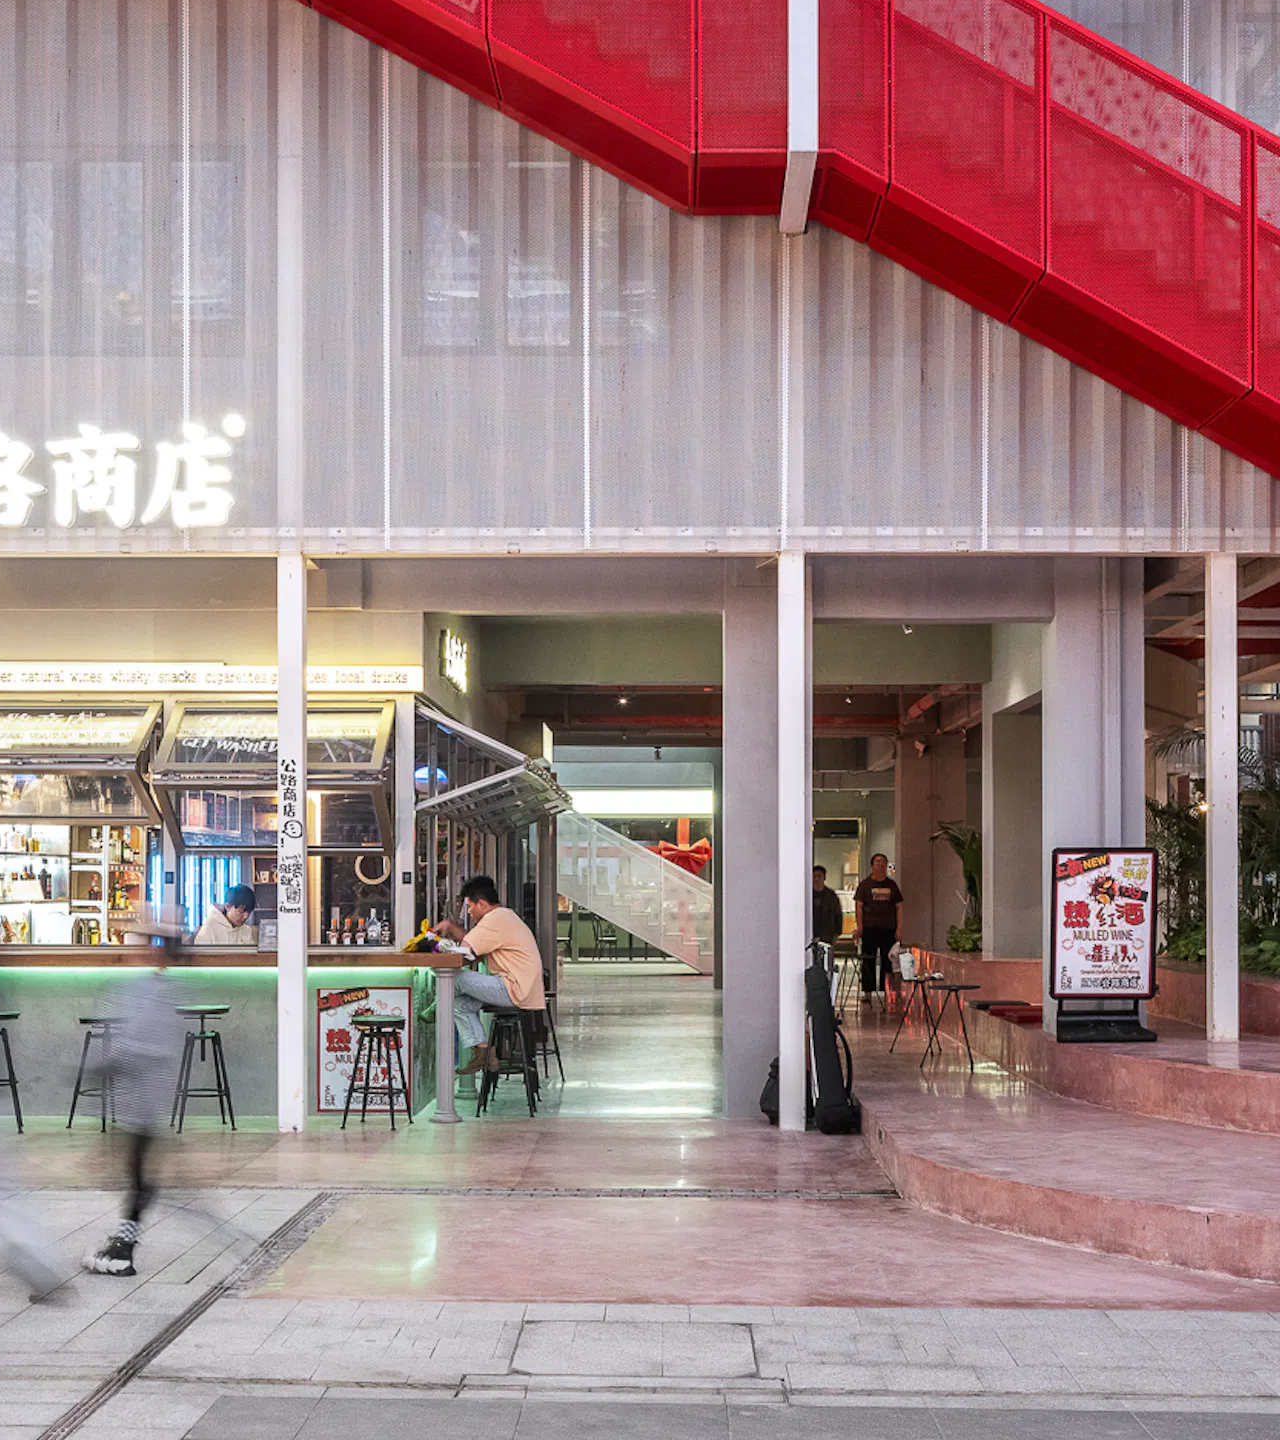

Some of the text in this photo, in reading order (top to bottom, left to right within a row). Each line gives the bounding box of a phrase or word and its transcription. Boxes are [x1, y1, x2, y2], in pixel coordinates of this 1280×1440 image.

[335, 669, 365, 684] local
[370, 669, 408, 684] drinks
[181, 738, 210, 748] GET
[280, 759, 298, 818] 公路商店
[1073, 929, 1134, 941] MULLED WINE
